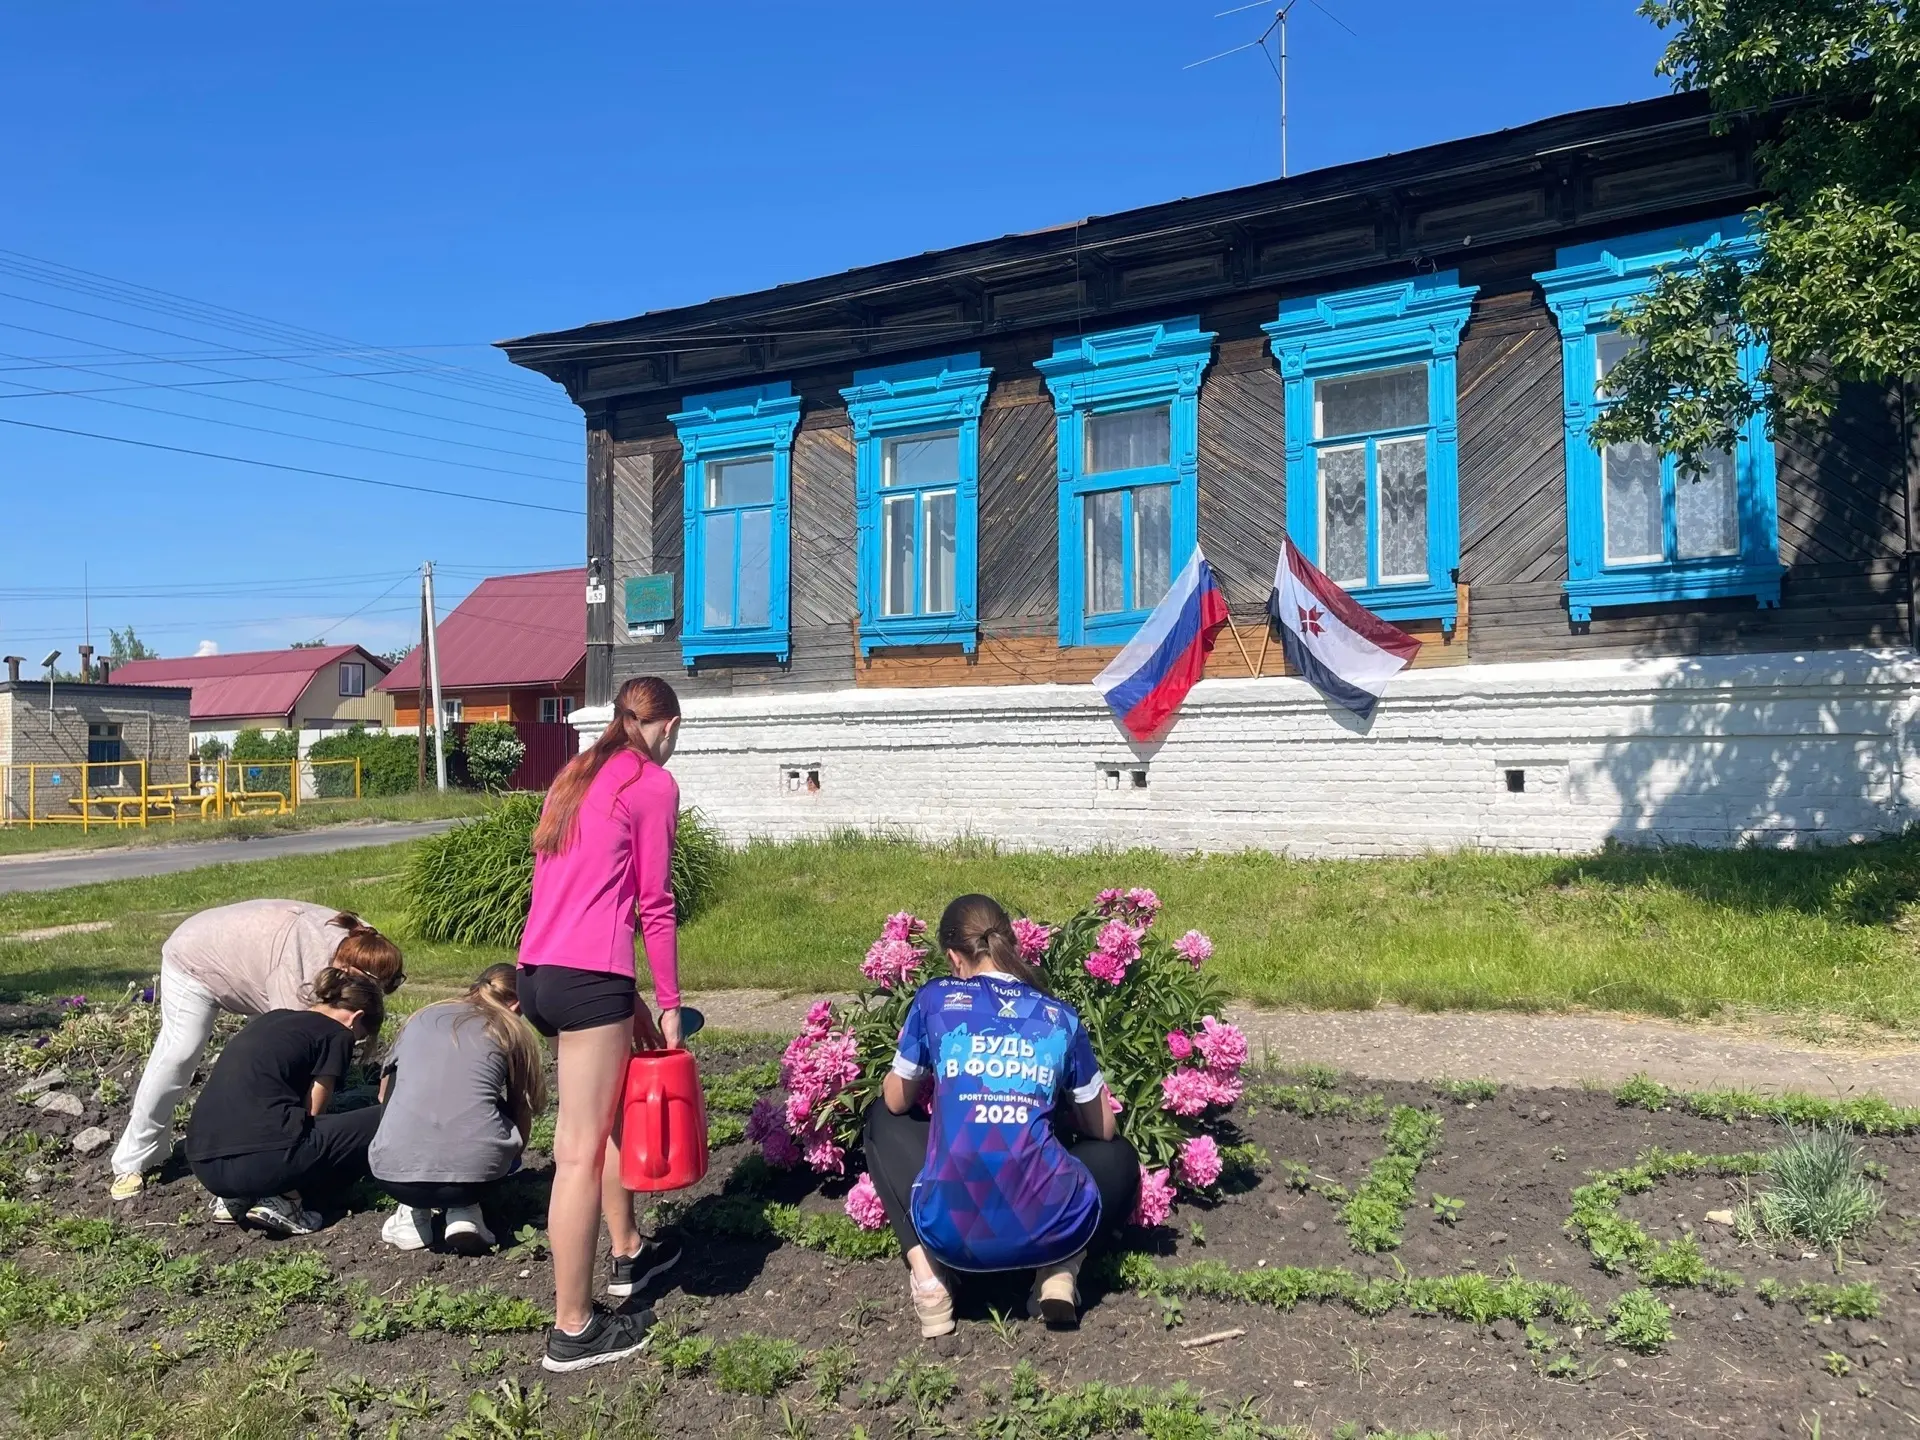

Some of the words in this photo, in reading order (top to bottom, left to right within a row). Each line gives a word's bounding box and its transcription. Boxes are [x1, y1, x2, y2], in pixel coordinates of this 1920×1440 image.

[594, 592, 603, 601] 53
[971, 1035, 1035, 1058] БУДЬ
[946, 1058, 960, 1078] В
[964, 1057, 1055, 1087] ФОРМЕ!
[958, 1093, 983, 1102] SPORT
[984, 1094, 1017, 1103] TOURISM
[1017, 1095, 1032, 1105] MARI
[974, 1104, 1029, 1124] 2026
